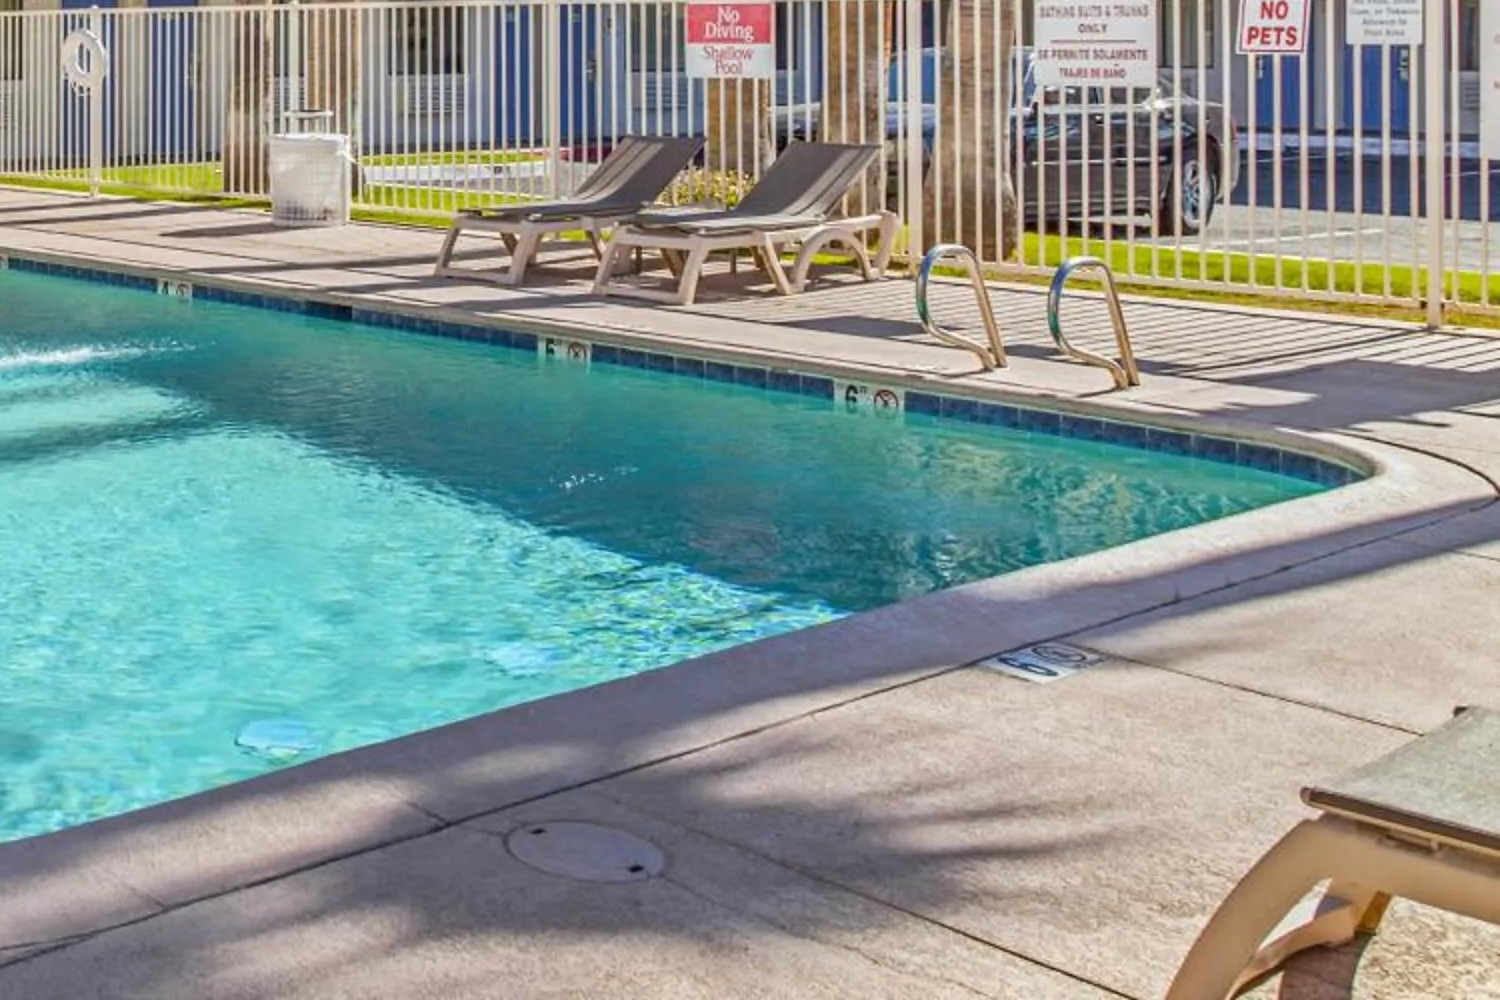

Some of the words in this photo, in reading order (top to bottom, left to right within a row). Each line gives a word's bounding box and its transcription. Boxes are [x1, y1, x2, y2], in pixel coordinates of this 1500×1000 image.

[718, 6, 740, 22] No
[1260, 0, 1289, 20] NO
[704, 21, 755, 43] Diving
[1247, 26, 1298, 46] PETS
[703, 46, 755, 60] Shallow
[715, 60, 743, 74] Pool
